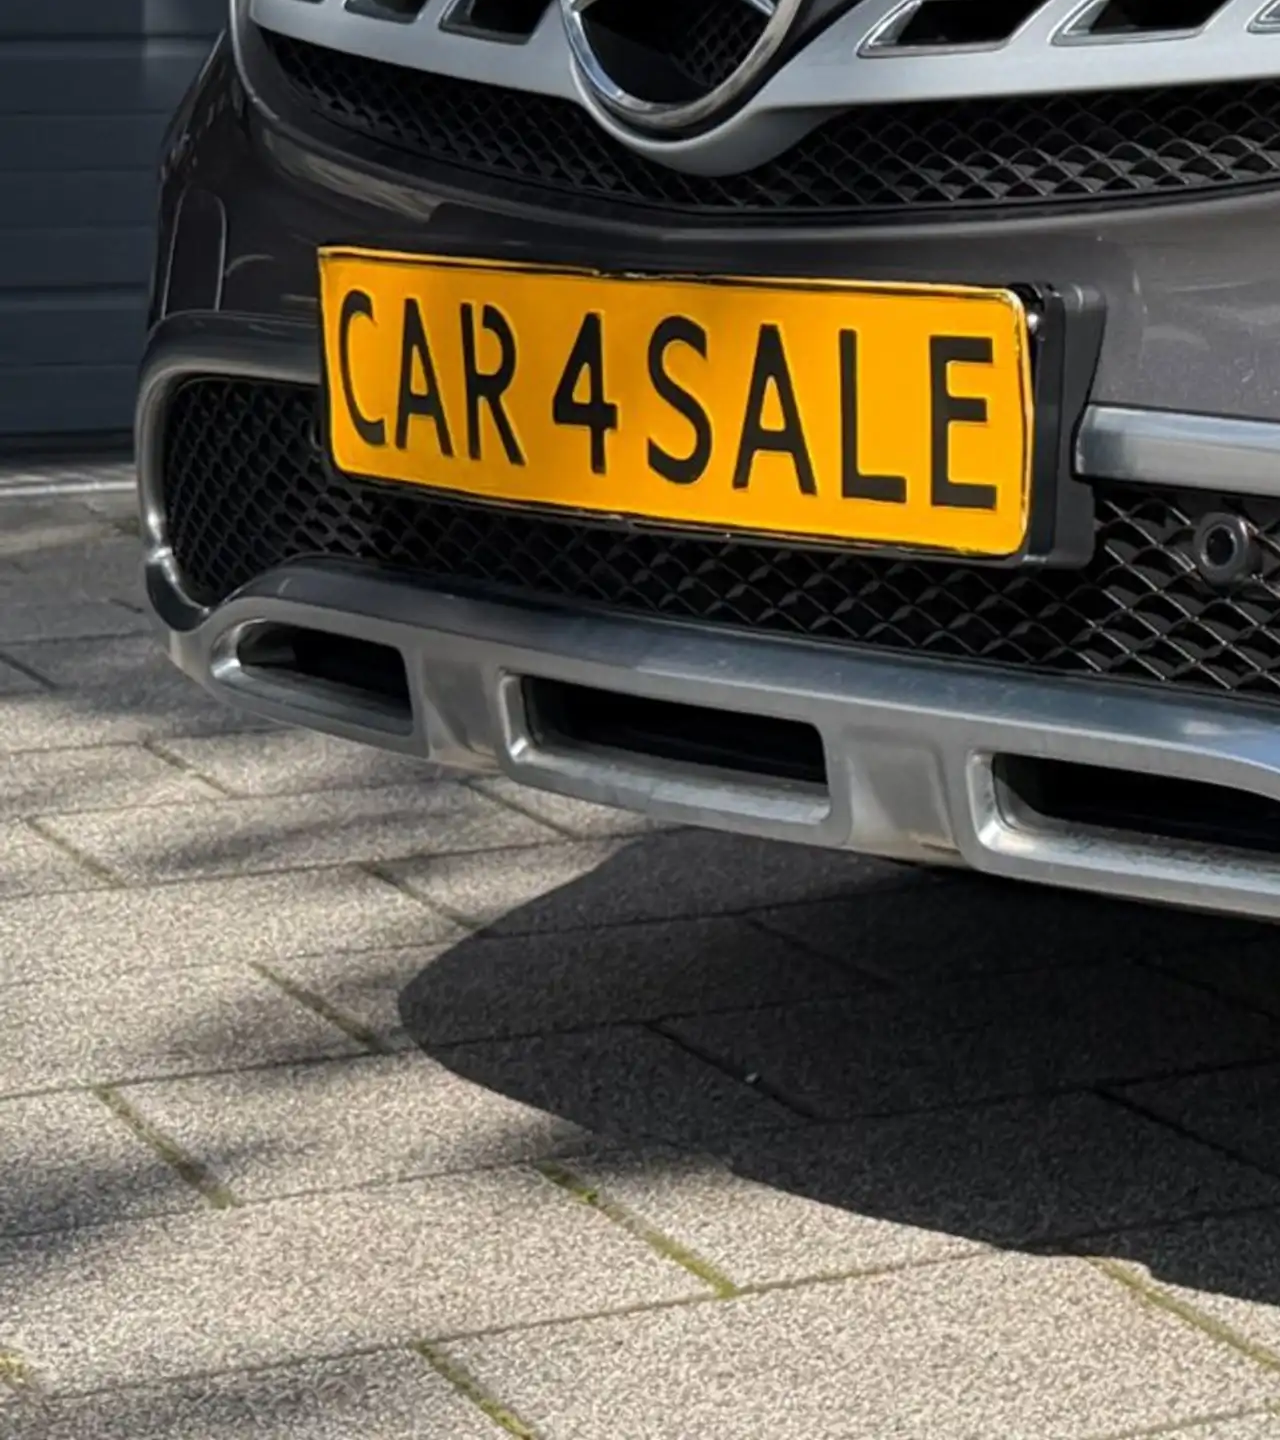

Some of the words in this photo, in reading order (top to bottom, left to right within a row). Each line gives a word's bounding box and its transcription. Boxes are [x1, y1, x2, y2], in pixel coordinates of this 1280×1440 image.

[339, 289, 526, 466] CAR
[552, 310, 618, 475] 4
[646, 315, 998, 510] SALE
